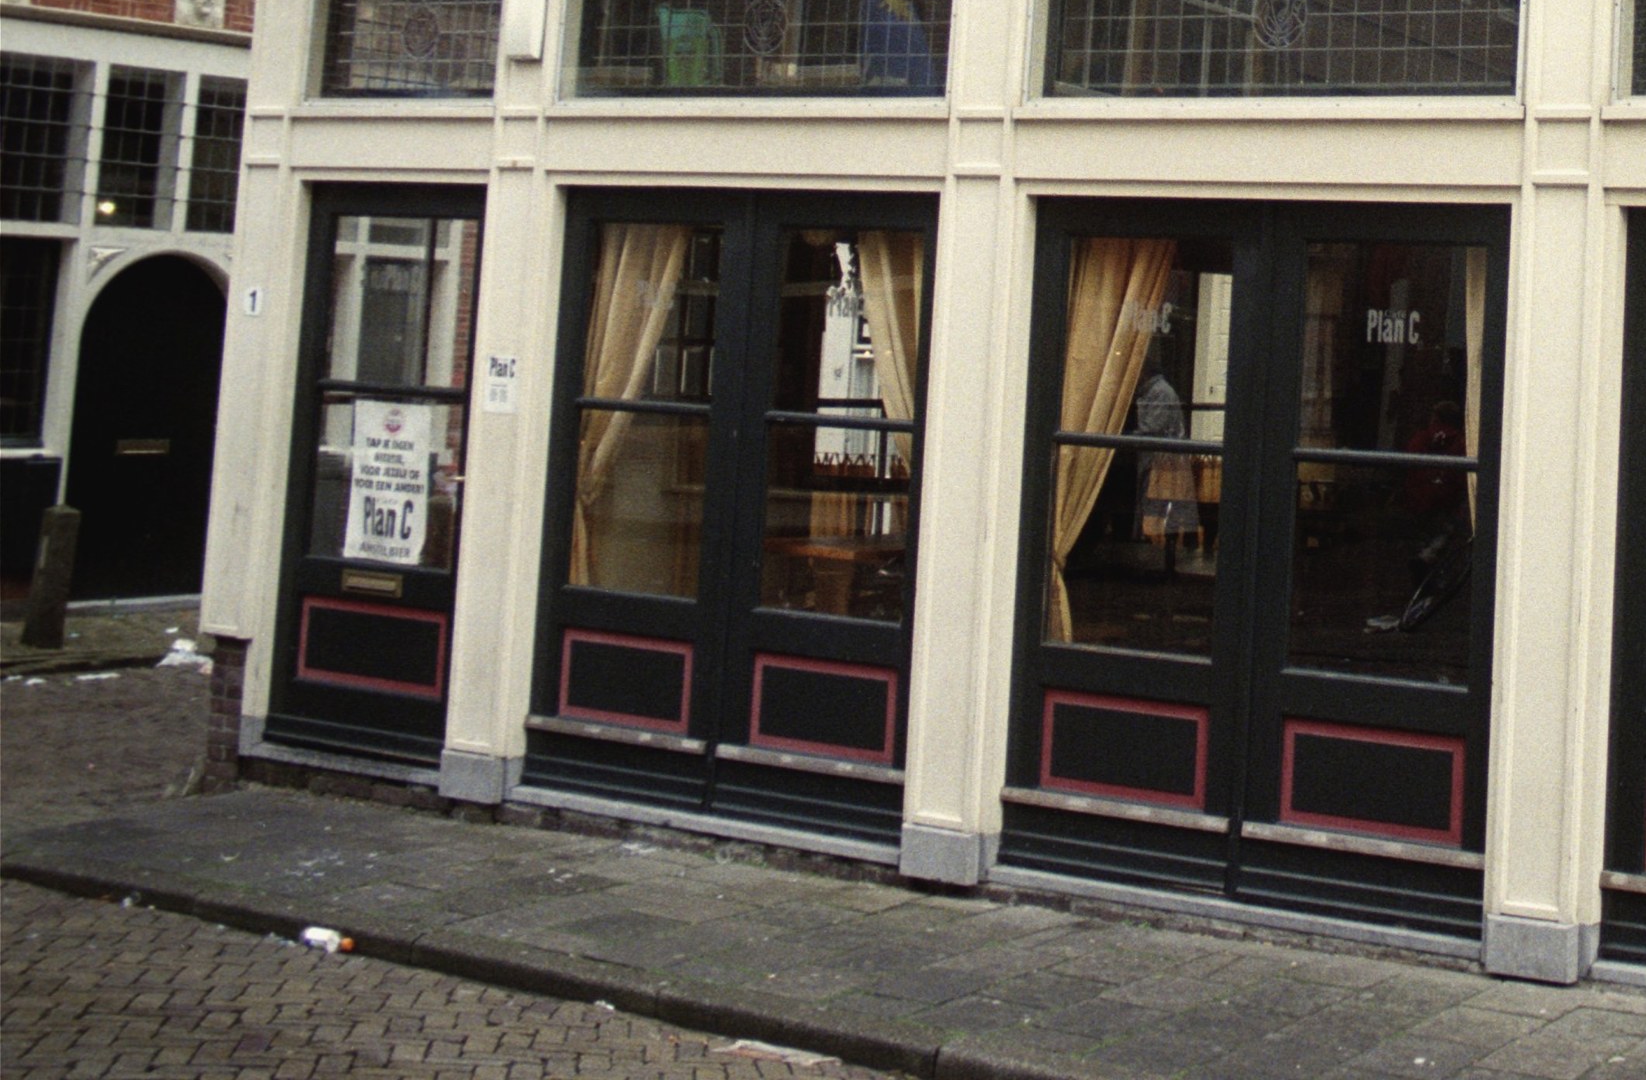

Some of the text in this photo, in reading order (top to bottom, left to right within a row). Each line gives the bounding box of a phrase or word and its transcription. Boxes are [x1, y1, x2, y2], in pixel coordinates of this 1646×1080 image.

[249, 290, 258, 312] 1
[1161, 301, 1172, 335] C
[1366, 308, 1421, 345] Plan C
[509, 358, 516, 378] C
[364, 495, 414, 540] Plan C
